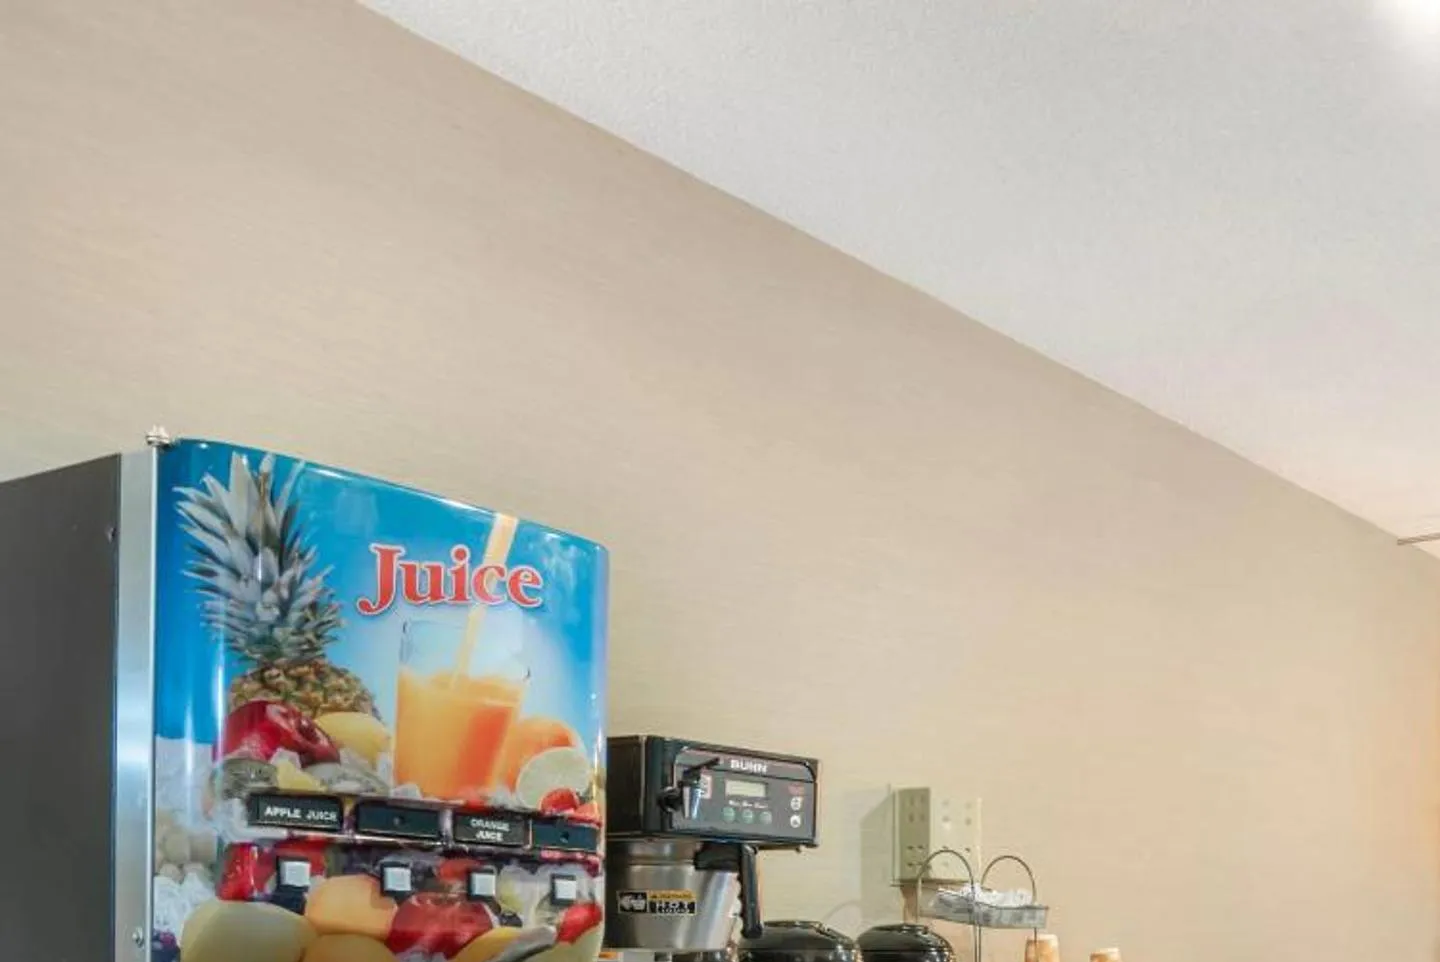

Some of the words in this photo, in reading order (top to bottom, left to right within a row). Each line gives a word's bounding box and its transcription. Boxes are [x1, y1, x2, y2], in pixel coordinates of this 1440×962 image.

[357, 543, 544, 615] Juice
[264, 806, 301, 819] APPLE
[306, 809, 337, 822] JUICE
[470, 818, 510, 832] ORANGE
[475, 829, 503, 842] JUICE
